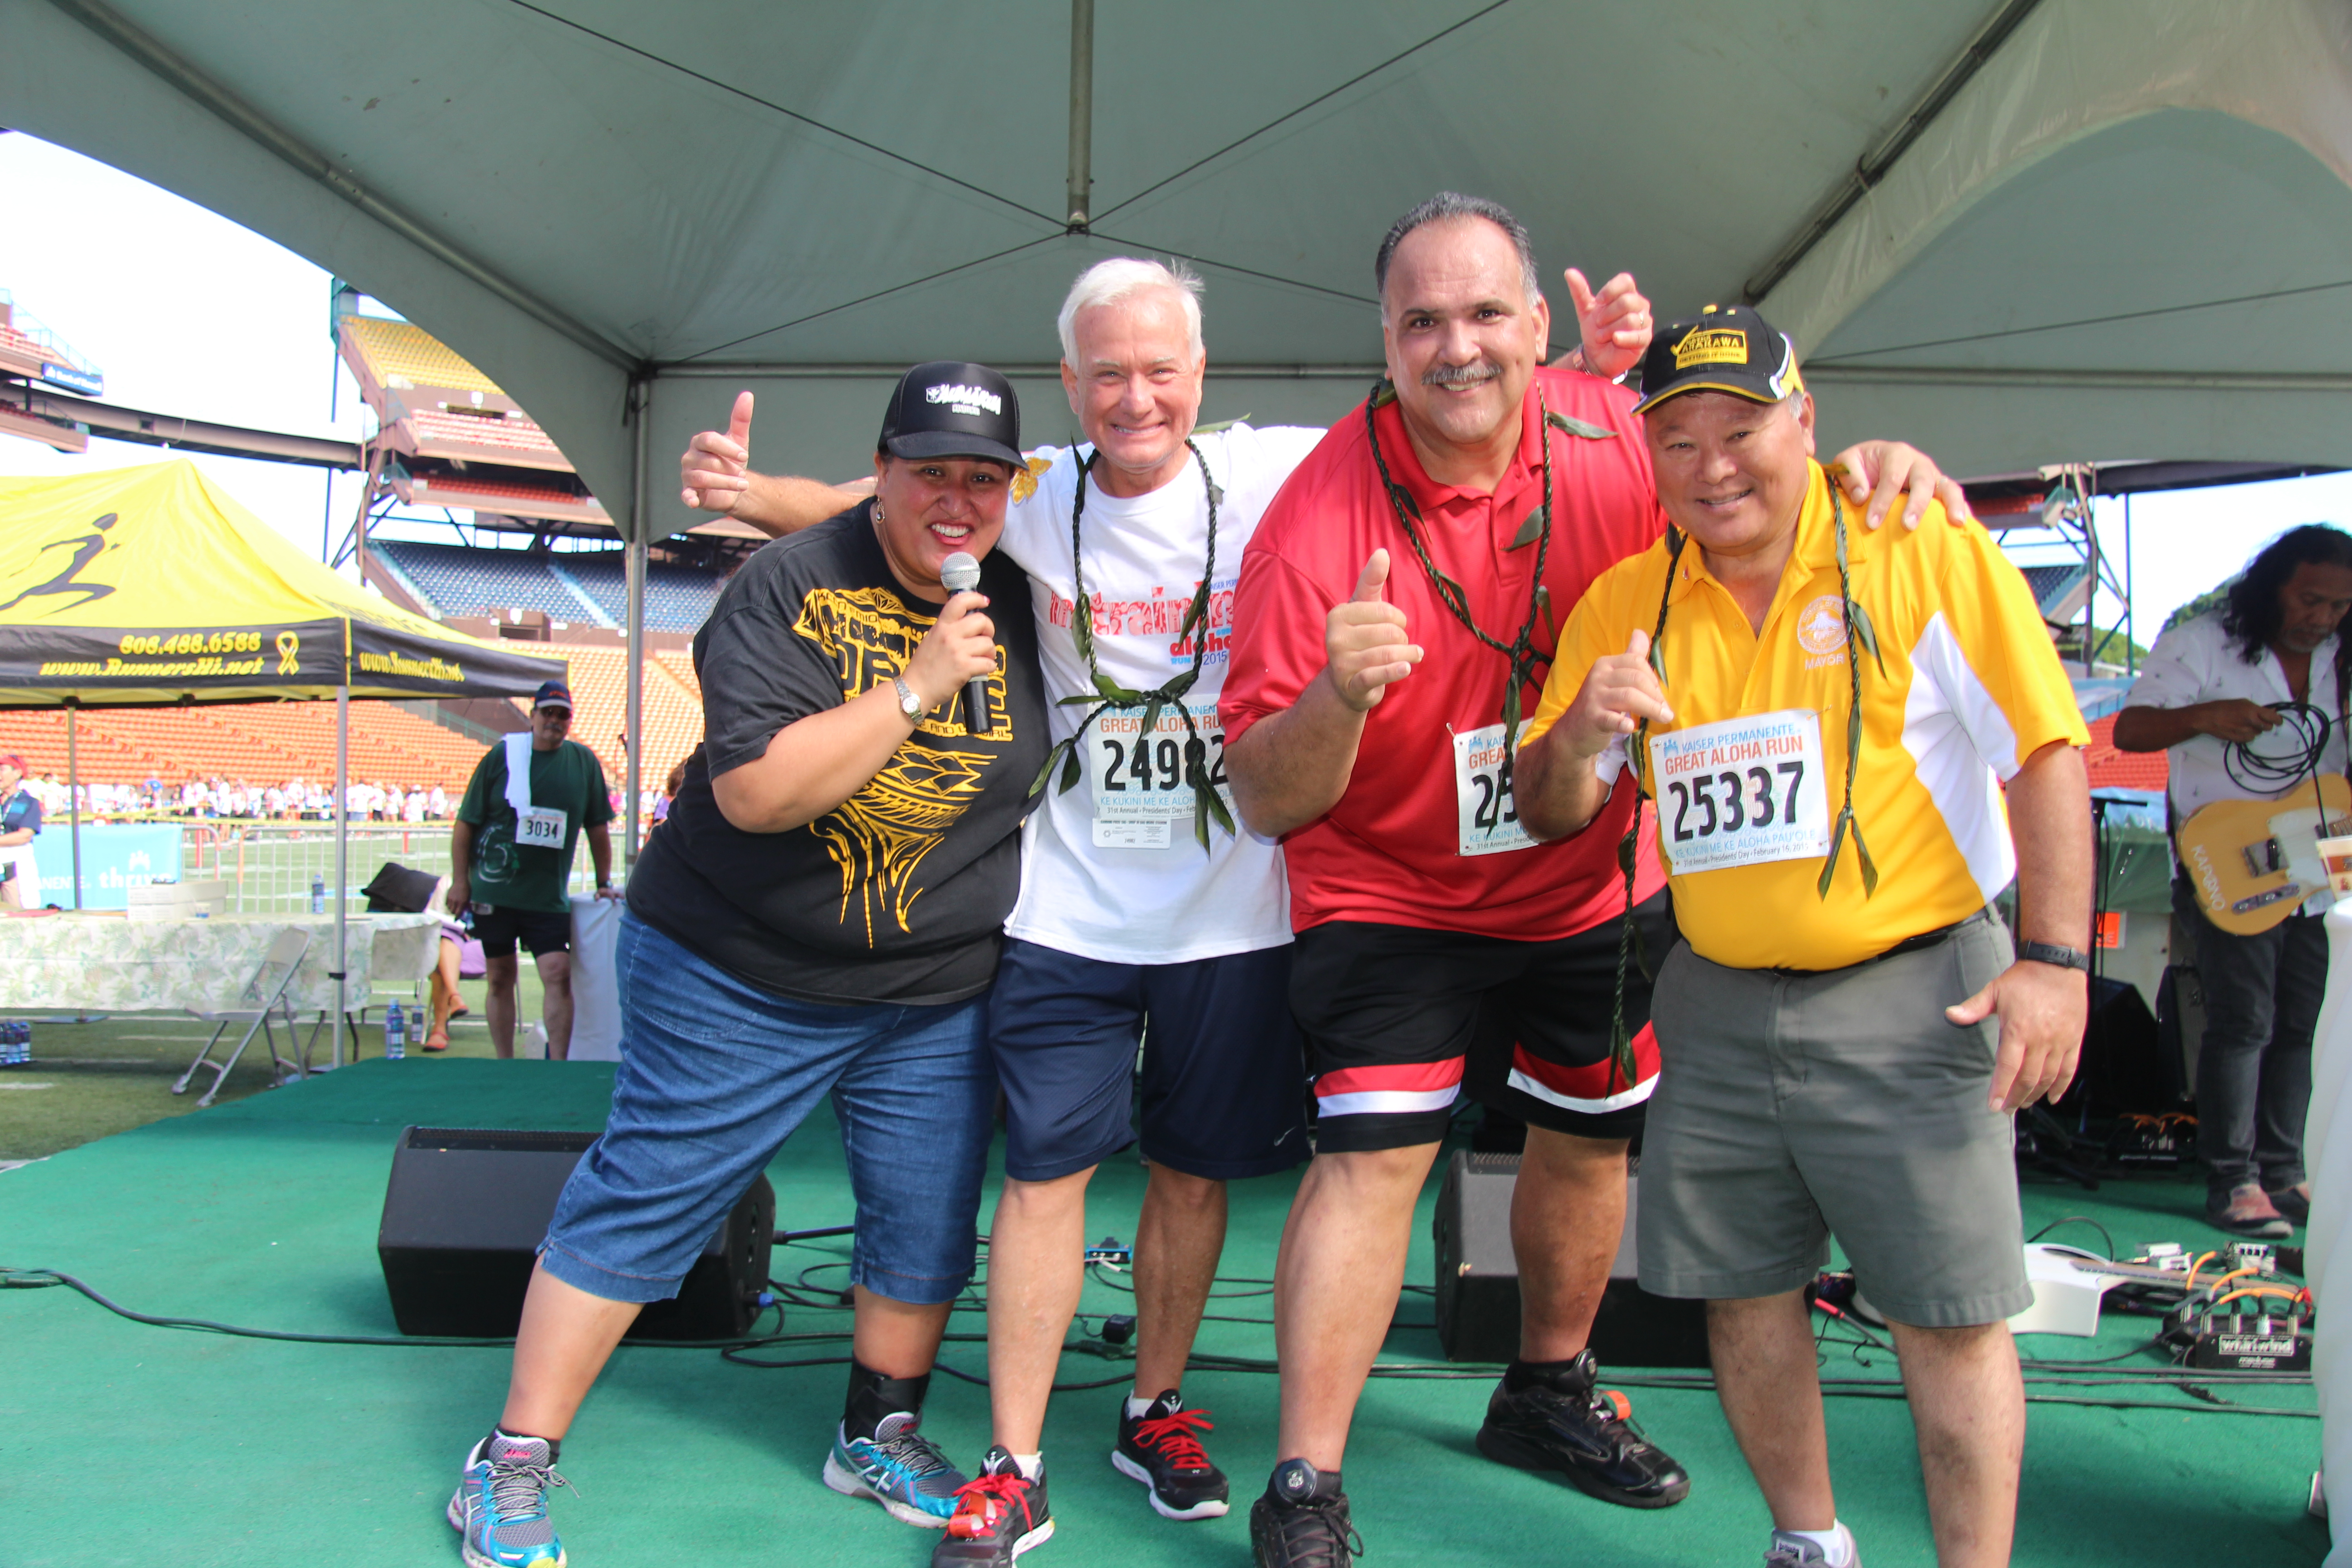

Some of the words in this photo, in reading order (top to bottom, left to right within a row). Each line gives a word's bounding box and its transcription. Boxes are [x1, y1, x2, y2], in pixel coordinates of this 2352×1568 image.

[1681, 336, 1740, 353] ARAKAWA
[1210, 581, 1225, 590] AISER
[119, 631, 263, 656] 808.488.6588
[39, 656, 265, 677] www.RunnersHi.net
[1203, 651, 1228, 666] 2015
[1806, 654, 1843, 670] MAYOR
[1121, 706, 1147, 717] KAISE
[1203, 715, 1223, 730] RU
[1487, 733, 1519, 748] KAISR
[1682, 737, 1714, 752] KAISER
[1718, 724, 1794, 746] PERMANENTE
[1102, 734, 1229, 791] 24982
[1468, 747, 1506, 769] GREA
[1665, 751, 1706, 776] GREAT
[1710, 740, 1762, 766] ALOHA
[1766, 735, 1803, 757] RUN
[1100, 797, 1111, 806] KE
[1112, 797, 1141, 806] KUKINI
[1144, 797, 1156, 806] ME
[1159, 797, 1170, 805] KE
[1172, 796, 1195, 805] ALOH
[1667, 760, 1804, 844] 25337
[1107, 806, 1118, 814] 31st
[1119, 806, 1138, 814] Annual
[1172, 806, 1183, 815] Day
[526, 820, 559, 839] 3034
[1469, 835, 1480, 843] KE
[1490, 839, 1510, 848] Annual
[1674, 848, 1685, 858] KE
[1686, 845, 1709, 857] KUKINI
[1711, 842, 1723, 853] ME
[1724, 840, 1735, 851] KE
[1737, 834, 1770, 849] ALOHA
[1738, 850, 1750, 861] Day
[1753, 844, 1780, 858] February
